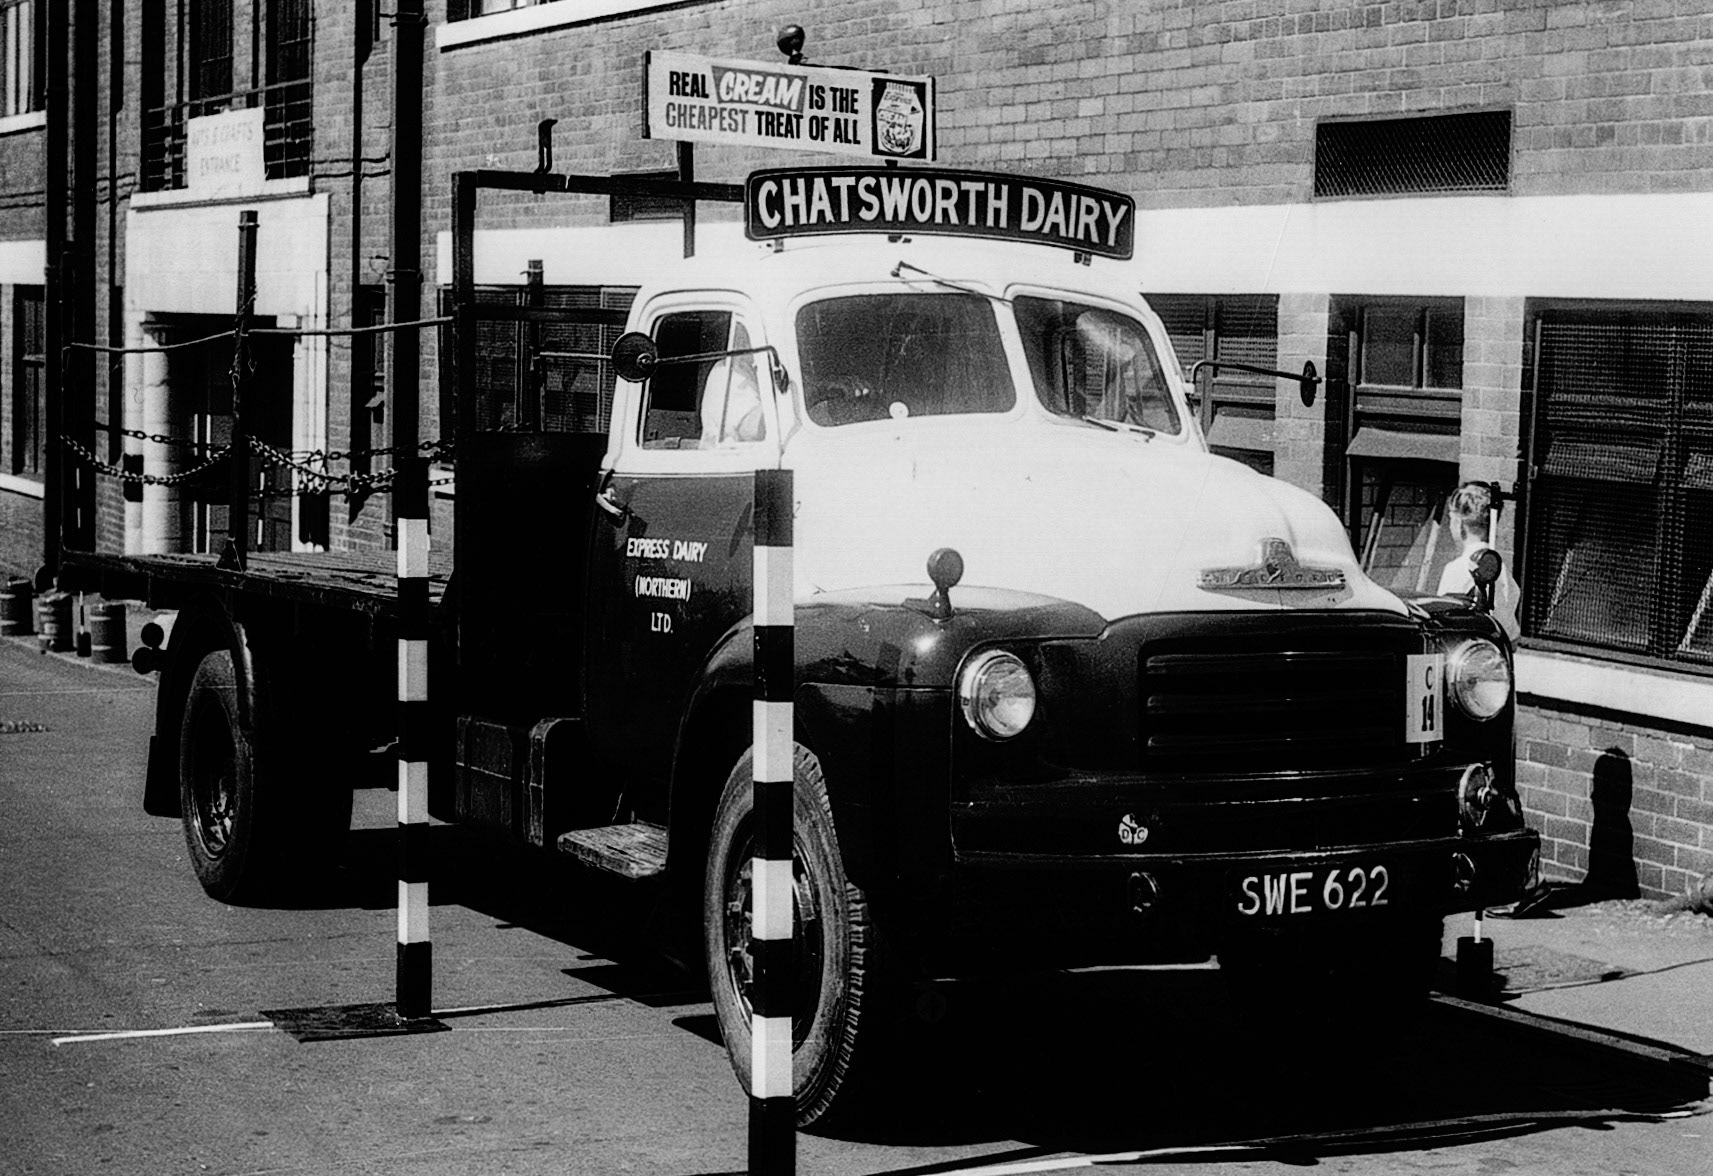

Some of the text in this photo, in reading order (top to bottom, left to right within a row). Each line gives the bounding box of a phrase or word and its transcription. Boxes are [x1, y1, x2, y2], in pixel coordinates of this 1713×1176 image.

[670, 71, 859, 114] REAL CREAM IS THE
[666, 102, 860, 145] CHEAPEST TREAT OF ALL
[758, 176, 1128, 247] CHATSWORTH DAIRY
[626, 537, 708, 562] EXPRESS DAIRY
[635, 574, 691, 602] (NORTHERN)
[651, 612, 673, 633] LTD.
[1425, 666, 1433, 690] C
[1421, 694, 1434, 732] 14
[1238, 865, 1389, 915] SWE 622
